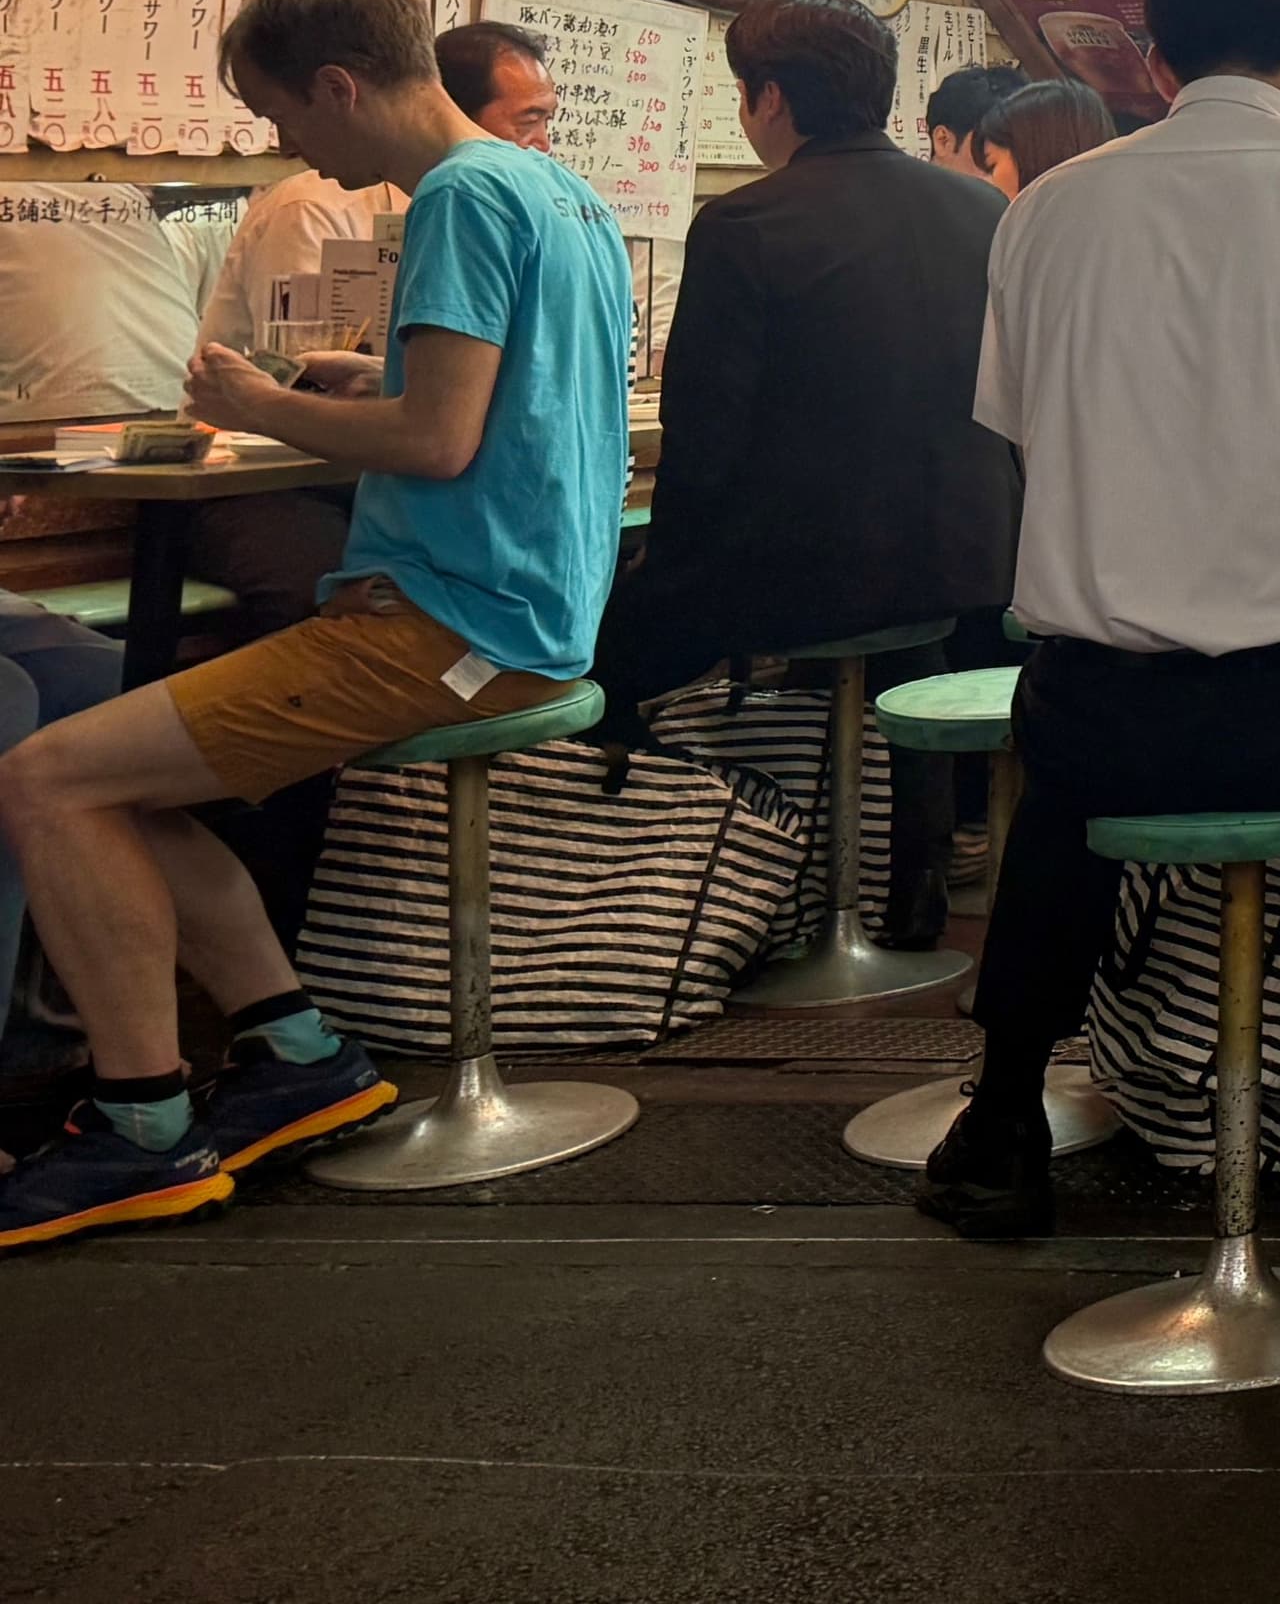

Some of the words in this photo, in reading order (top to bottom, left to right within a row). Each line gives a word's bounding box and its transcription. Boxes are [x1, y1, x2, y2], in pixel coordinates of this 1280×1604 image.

[638, 28, 663, 45] 650
[943, 10, 954, 63] 生ビール
[625, 48, 648, 65] 580
[627, 136, 651, 153] 390
[638, 159, 660, 173] 300
